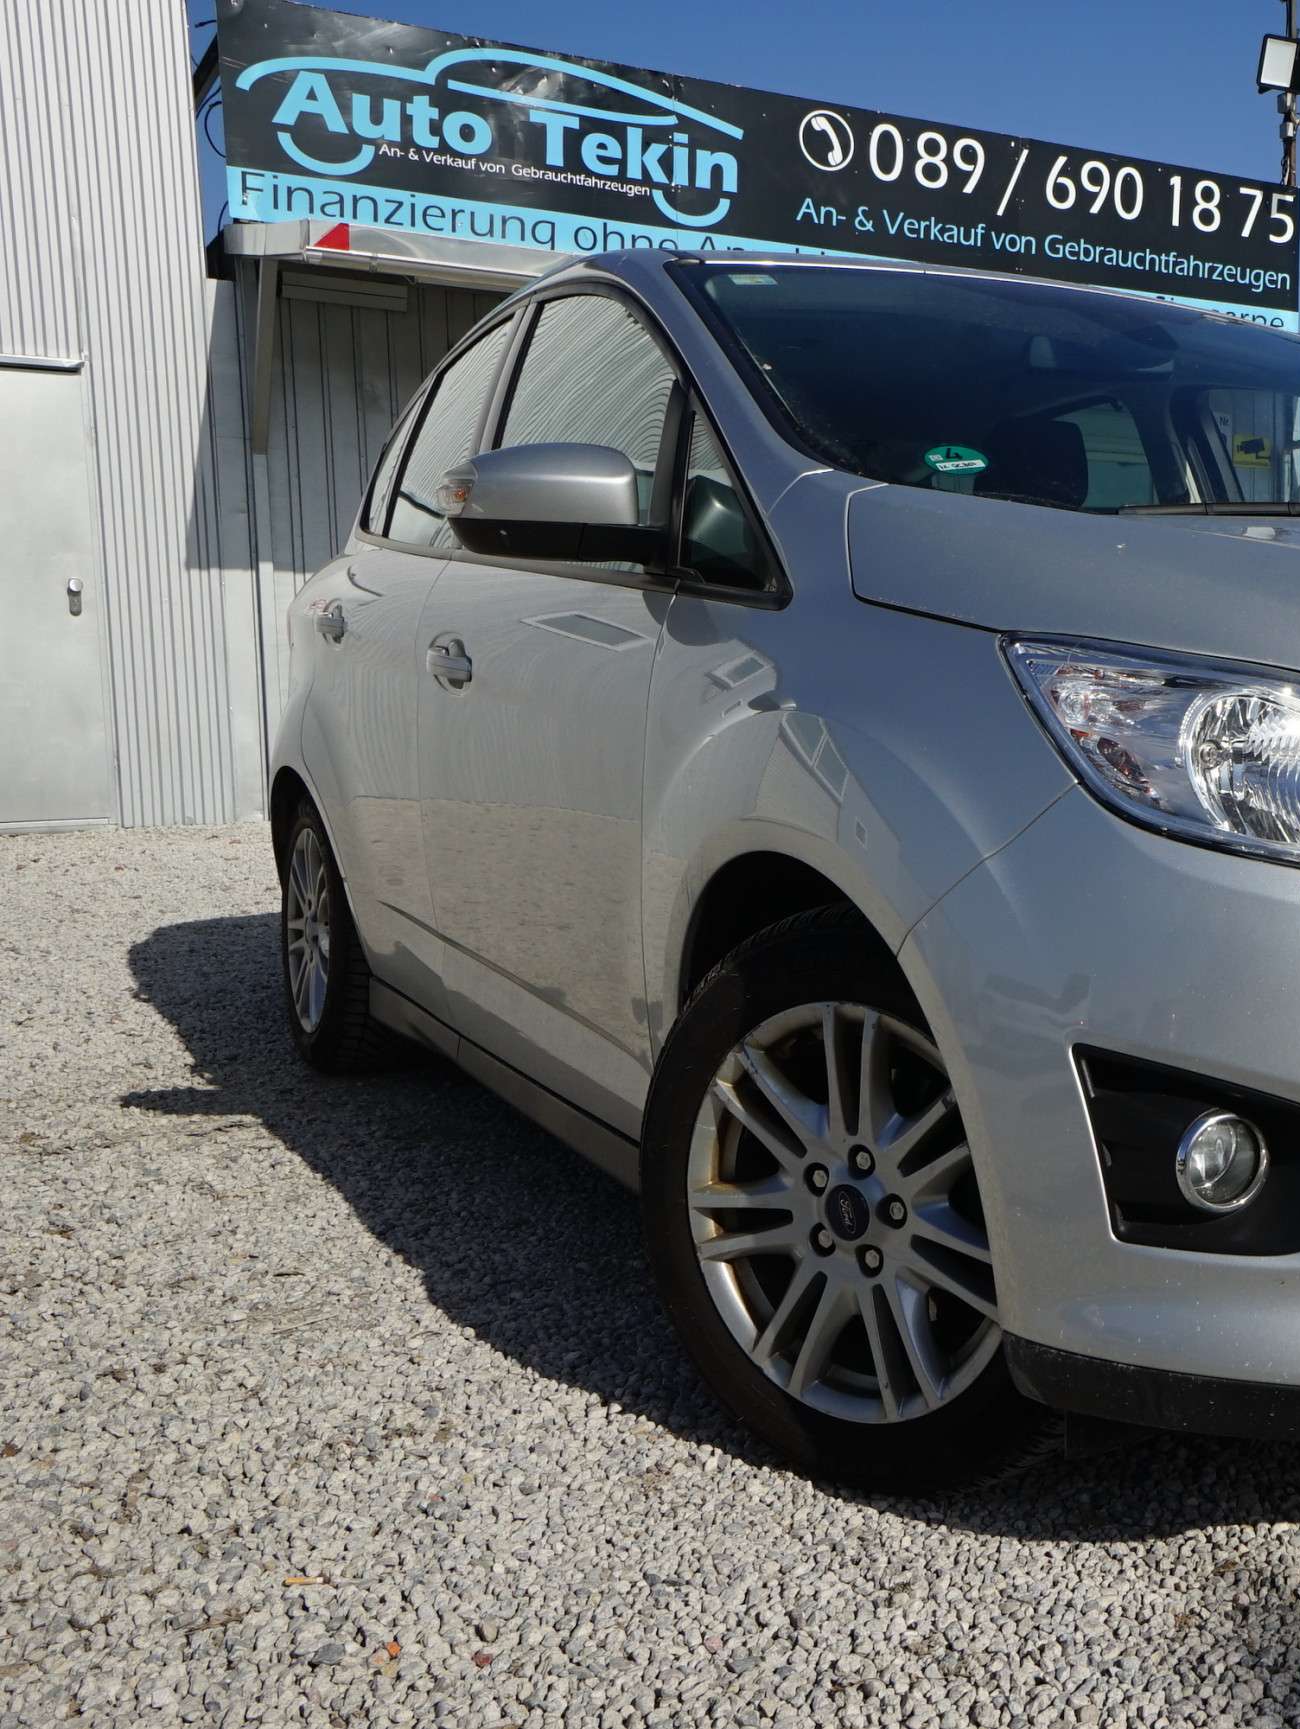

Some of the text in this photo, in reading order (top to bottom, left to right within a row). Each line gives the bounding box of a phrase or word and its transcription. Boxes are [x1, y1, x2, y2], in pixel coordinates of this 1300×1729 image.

[272, 71, 738, 194] Auto Tekin
[378, 143, 650, 197] An- & Verkauf von Gebrauchtfahrzeugen
[869, 123, 1295, 244] 089 / 690 18 75
[796, 198, 1291, 293] An- & Verkauf von Gebrauchtfahrzeugen
